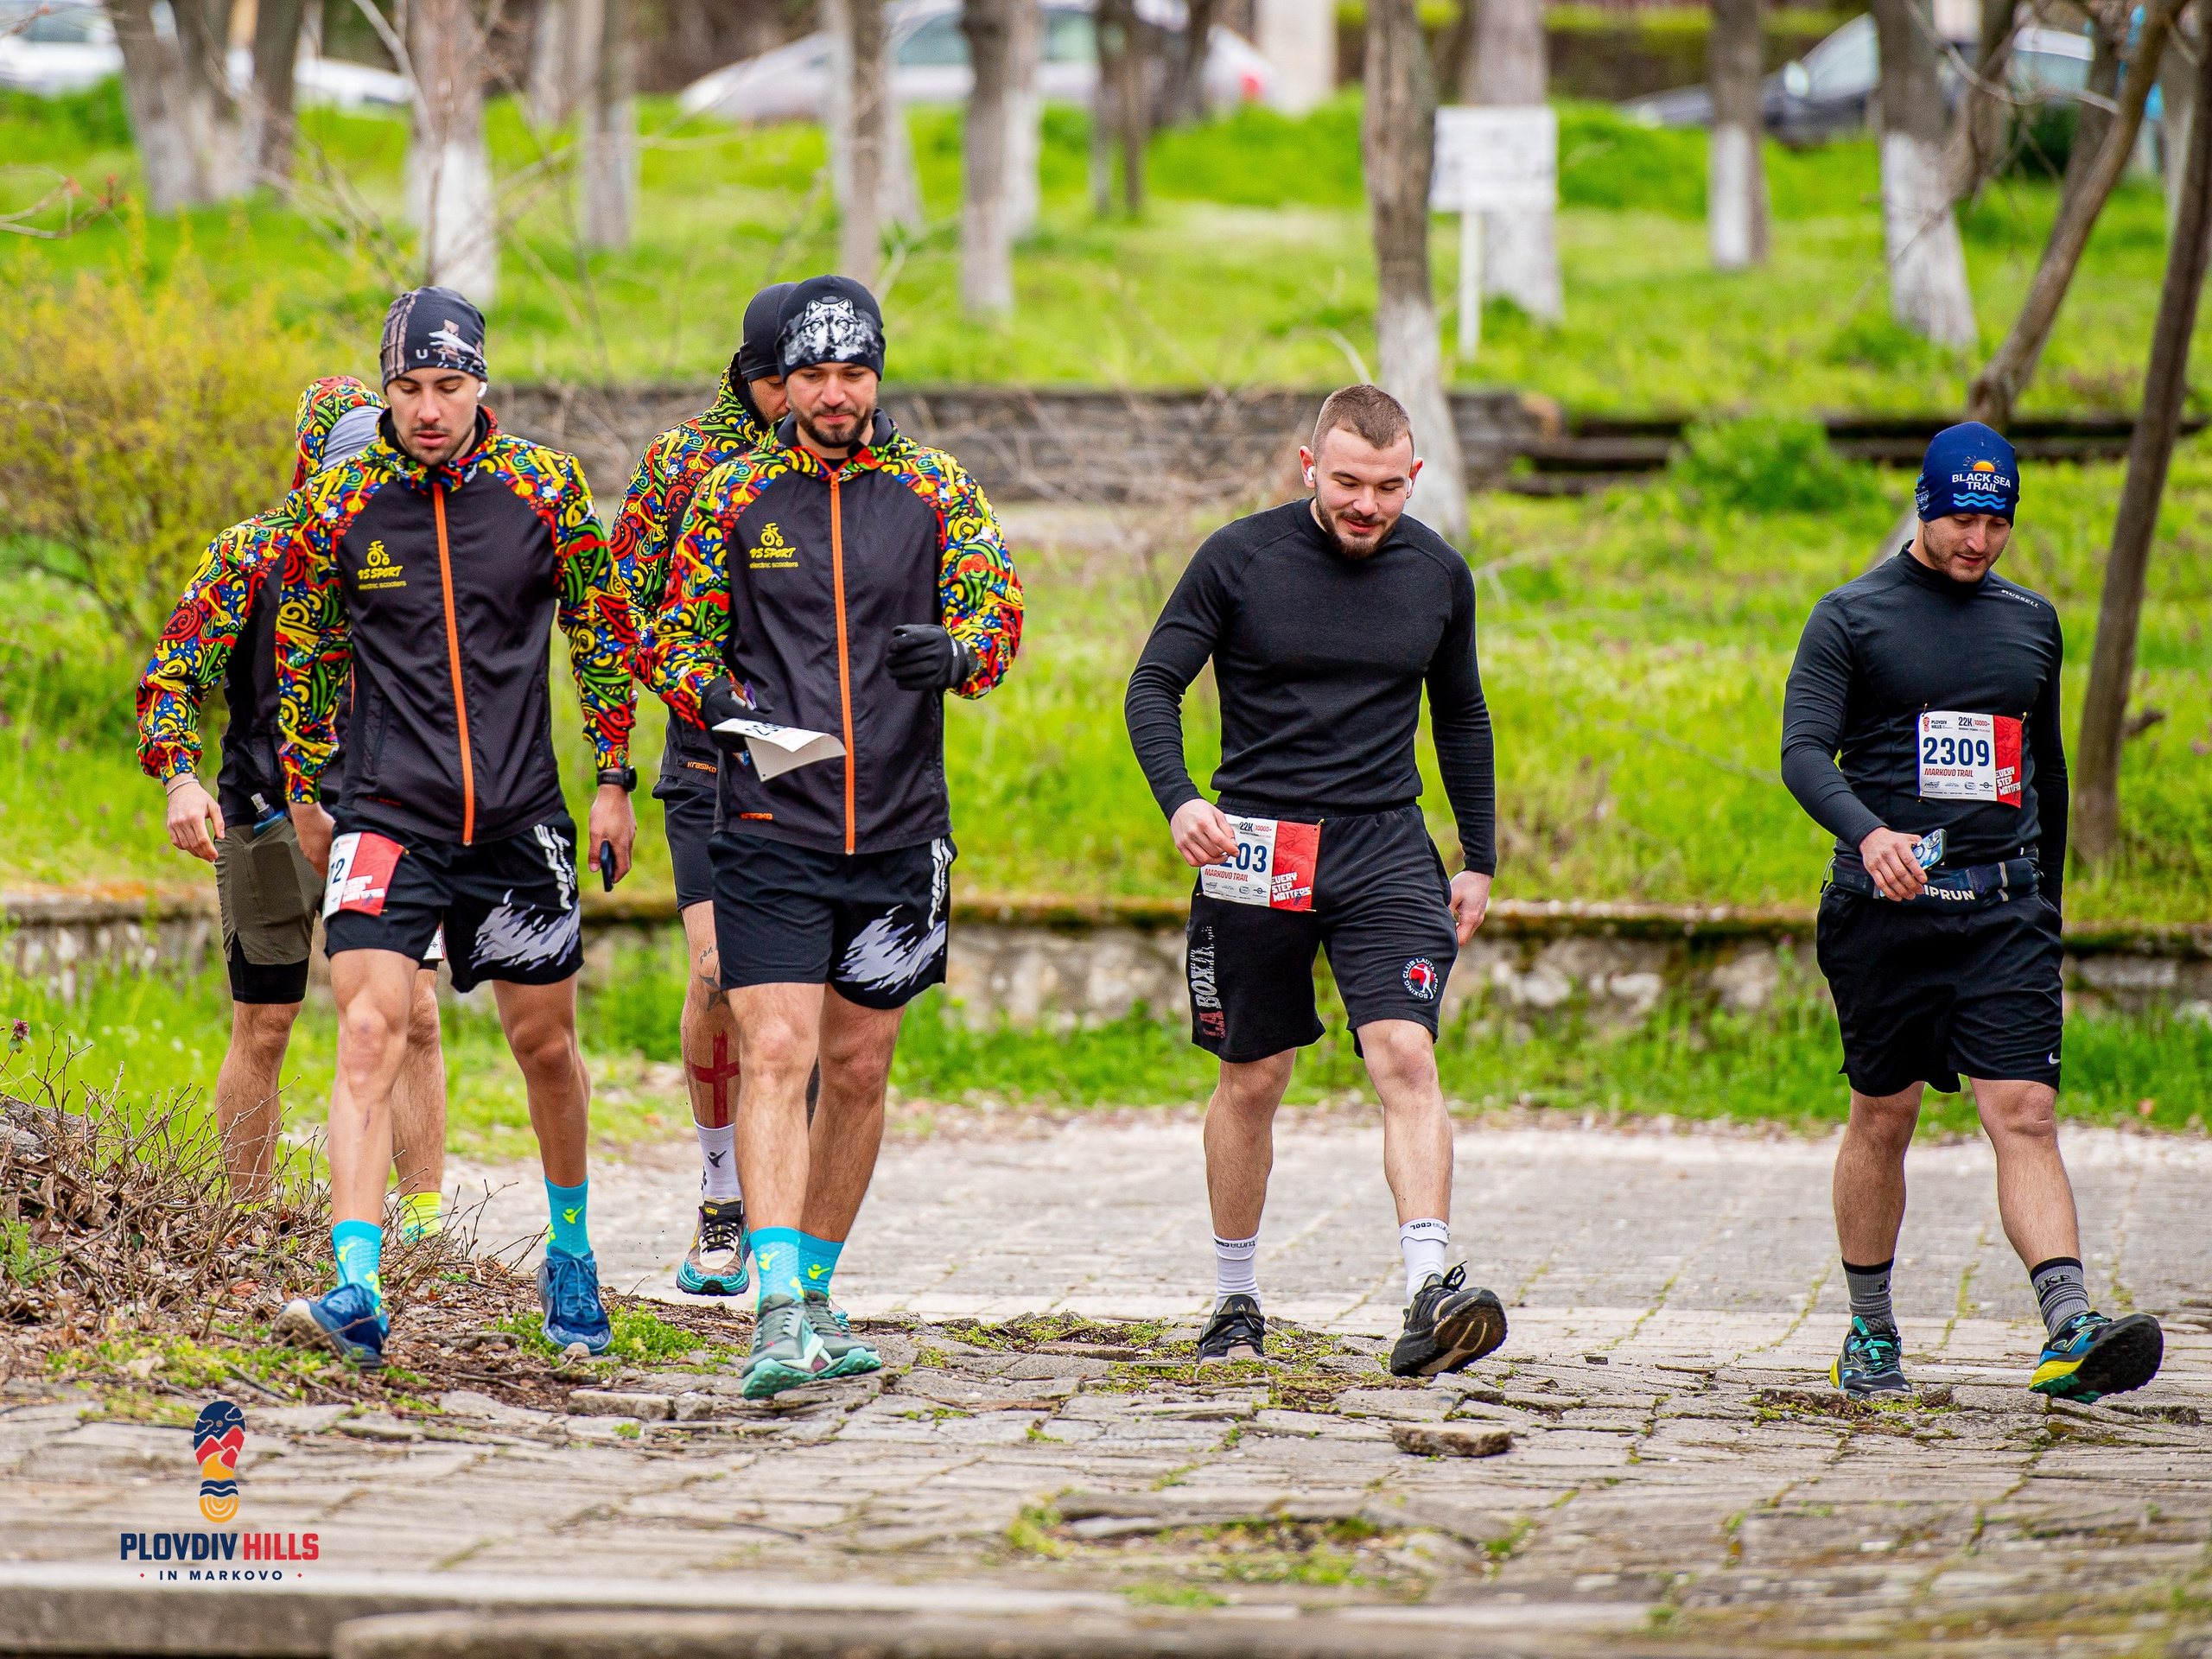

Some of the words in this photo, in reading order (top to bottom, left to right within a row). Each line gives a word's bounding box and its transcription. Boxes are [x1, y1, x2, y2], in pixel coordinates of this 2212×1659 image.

[1952, 473, 1992, 483] BLACK
[1993, 475, 2012, 488] SEA
[1966, 481, 1999, 493] TRAIL
[763, 547, 797, 559] SPORT
[1958, 716, 1973, 727] 22K
[1923, 736, 1990, 767] 2309
[1923, 768, 1956, 777] MARKOVO
[1956, 769, 1974, 778] TRAIL
[1996, 766, 2015, 779] EVERY
[1996, 775, 2012, 787] STEP
[1239, 821, 1254, 832] 22K
[1205, 868, 1233, 880] MARKOVO
[1233, 872, 1249, 882] TRAIL
[1271, 871, 1298, 885] EVERY
[1271, 882, 1293, 894] STEP
[1273, 887, 1312, 902] MATTERS
[1923, 884, 1975, 900] IPRUN
[1402, 960, 1415, 978] CLUB
[1415, 958, 1435, 971] LAUTA
[1404, 980, 1428, 999] BOXING
[1199, 1010, 1225, 1039] LA
[2037, 1274, 2071, 1294] IKE
